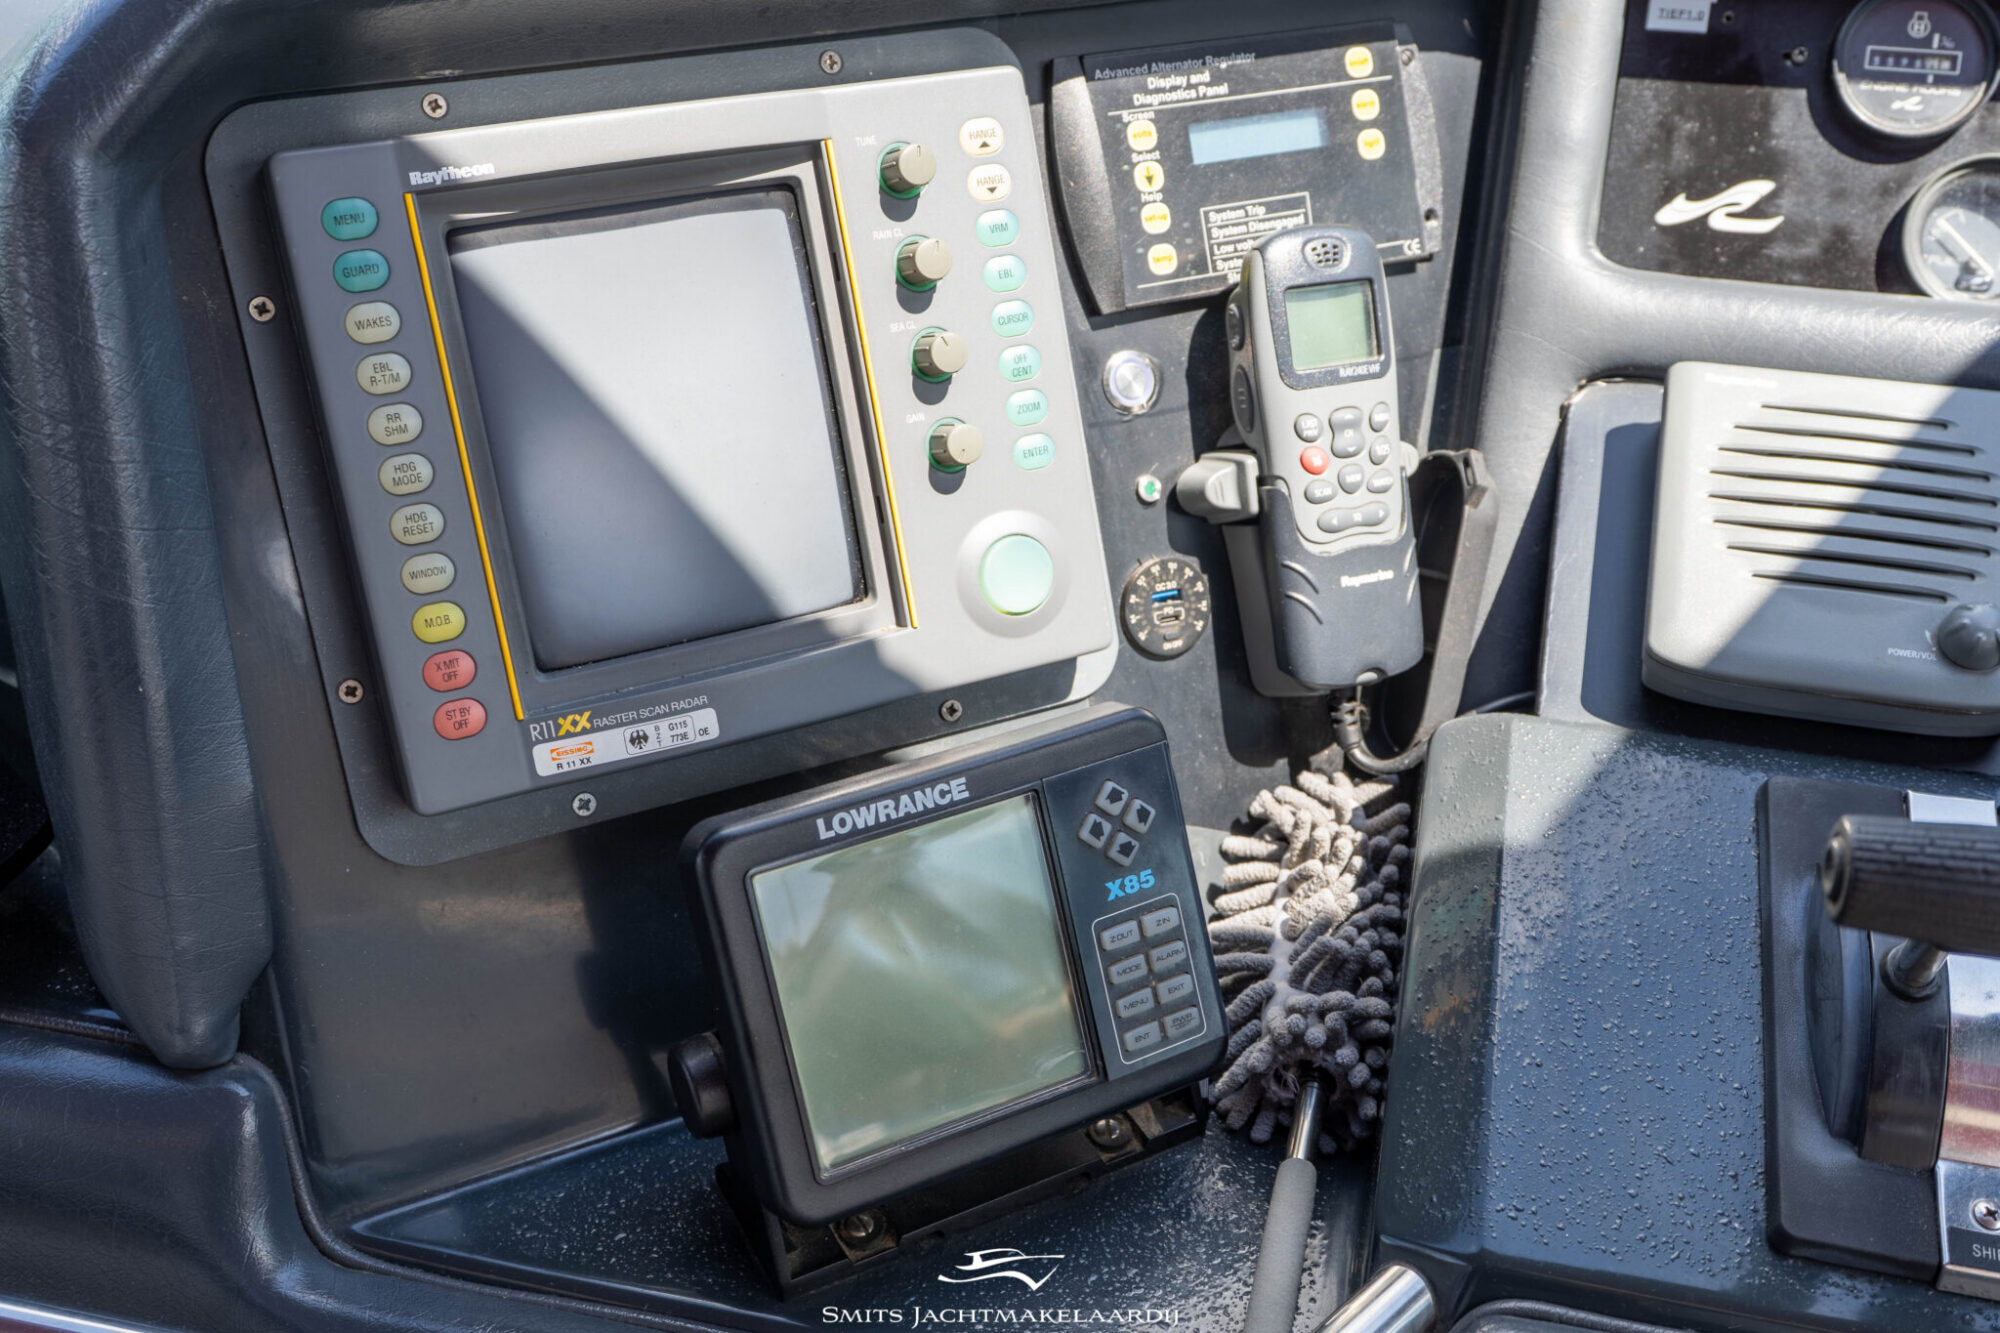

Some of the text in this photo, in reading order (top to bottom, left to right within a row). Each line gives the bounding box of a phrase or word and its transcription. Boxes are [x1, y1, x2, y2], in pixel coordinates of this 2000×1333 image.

[1094, 52, 1256, 80] Advanced Alternator Regulator
[1147, 70, 1211, 90] Display and
[1133, 82, 1229, 106] Diagnostics Panel
[1122, 110, 1155, 123] Screen
[408, 162, 496, 186] Raytheon
[1141, 191, 1163, 203] Help
[333, 213, 366, 227] MENU
[988, 222, 1009, 235] VRM
[342, 263, 380, 278] GUARD
[997, 269, 1014, 280] EBL
[354, 315, 393, 331] WAKES
[998, 311, 1029, 326] CURSOR
[372, 362, 394, 374] EBL
[369, 372, 402, 387] R-T/M
[1017, 401, 1041, 415] ZOOM
[385, 412, 402, 424] RR
[384, 423, 409, 437] SHM
[1023, 445, 1049, 459] ENTER
[393, 461, 417, 475] HDG
[392, 473, 424, 487] MODE
[404, 511, 428, 525] HDG
[403, 522, 435, 537] RESET
[409, 565, 448, 581] WINDOW
[424, 614, 453, 629] M.O.B.
[442, 669, 459, 683] OFF
[445, 706, 471, 722] ST BY
[593, 711, 638, 729] RASTER
[639, 703, 670, 719] SCAN
[671, 694, 709, 713] RADAR
[453, 718, 470, 731] OFF
[668, 719, 688, 732] G115
[556, 756, 592, 771] R 11 XX
[816, 776, 970, 840] LOWRANCE
[1104, 868, 1156, 902] X85
[1156, 947, 1185, 962] ALARM
[1116, 962, 1142, 977] MODE
[1168, 982, 1185, 994] EXIT
[1124, 997, 1149, 1012] MENU
[1134, 1031, 1150, 1043] ENT
